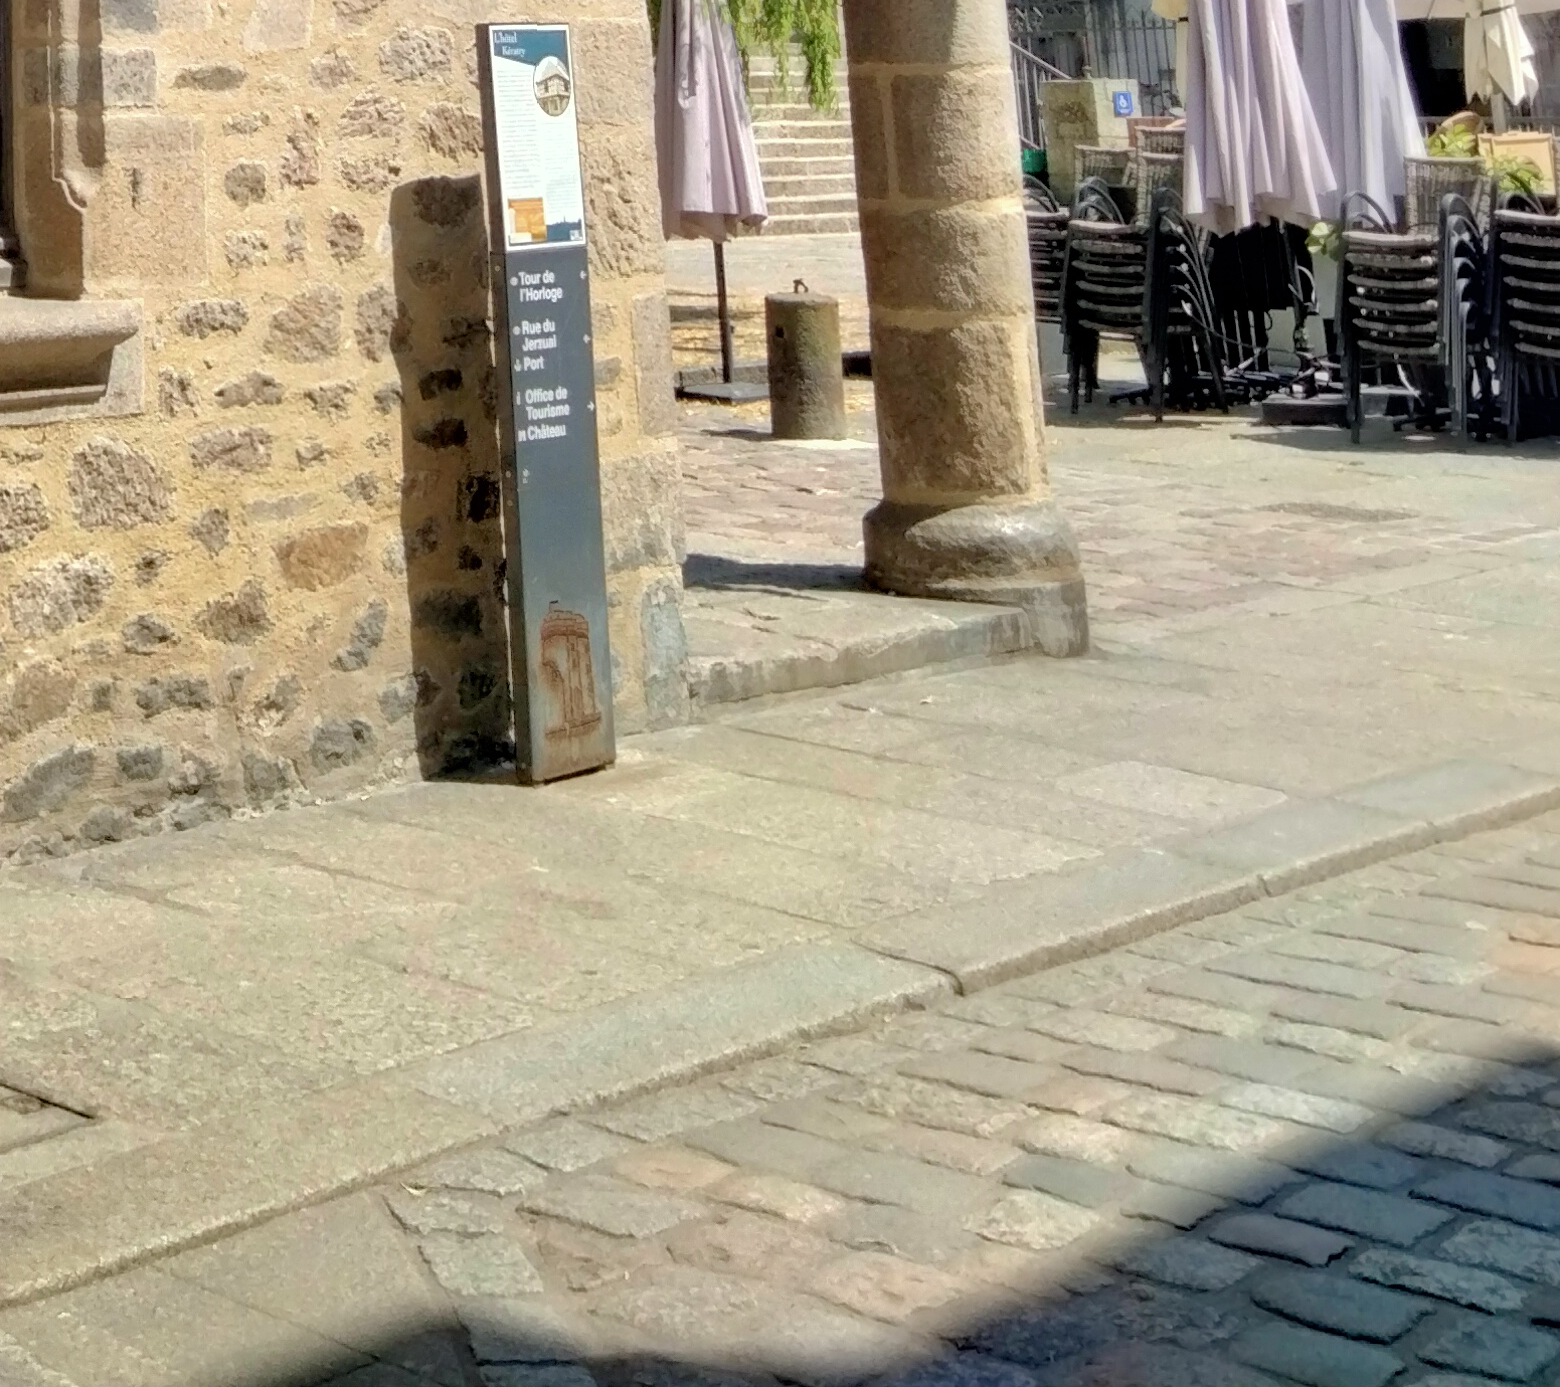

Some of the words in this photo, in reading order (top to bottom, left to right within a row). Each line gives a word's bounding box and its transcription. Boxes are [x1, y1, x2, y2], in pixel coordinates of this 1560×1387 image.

[518, 271, 541, 286] Tour
[542, 270, 555, 284] de
[519, 286, 563, 303] l'Horloge
[521, 320, 542, 335] Rue
[542, 318, 556, 333] du
[522, 334, 558, 351] Jerzual
[523, 355, 545, 371] Port
[525, 388, 554, 404] Office
[555, 386, 568, 400] de
[525, 403, 571, 421] Tourisme
[527, 423, 567, 441] Château
